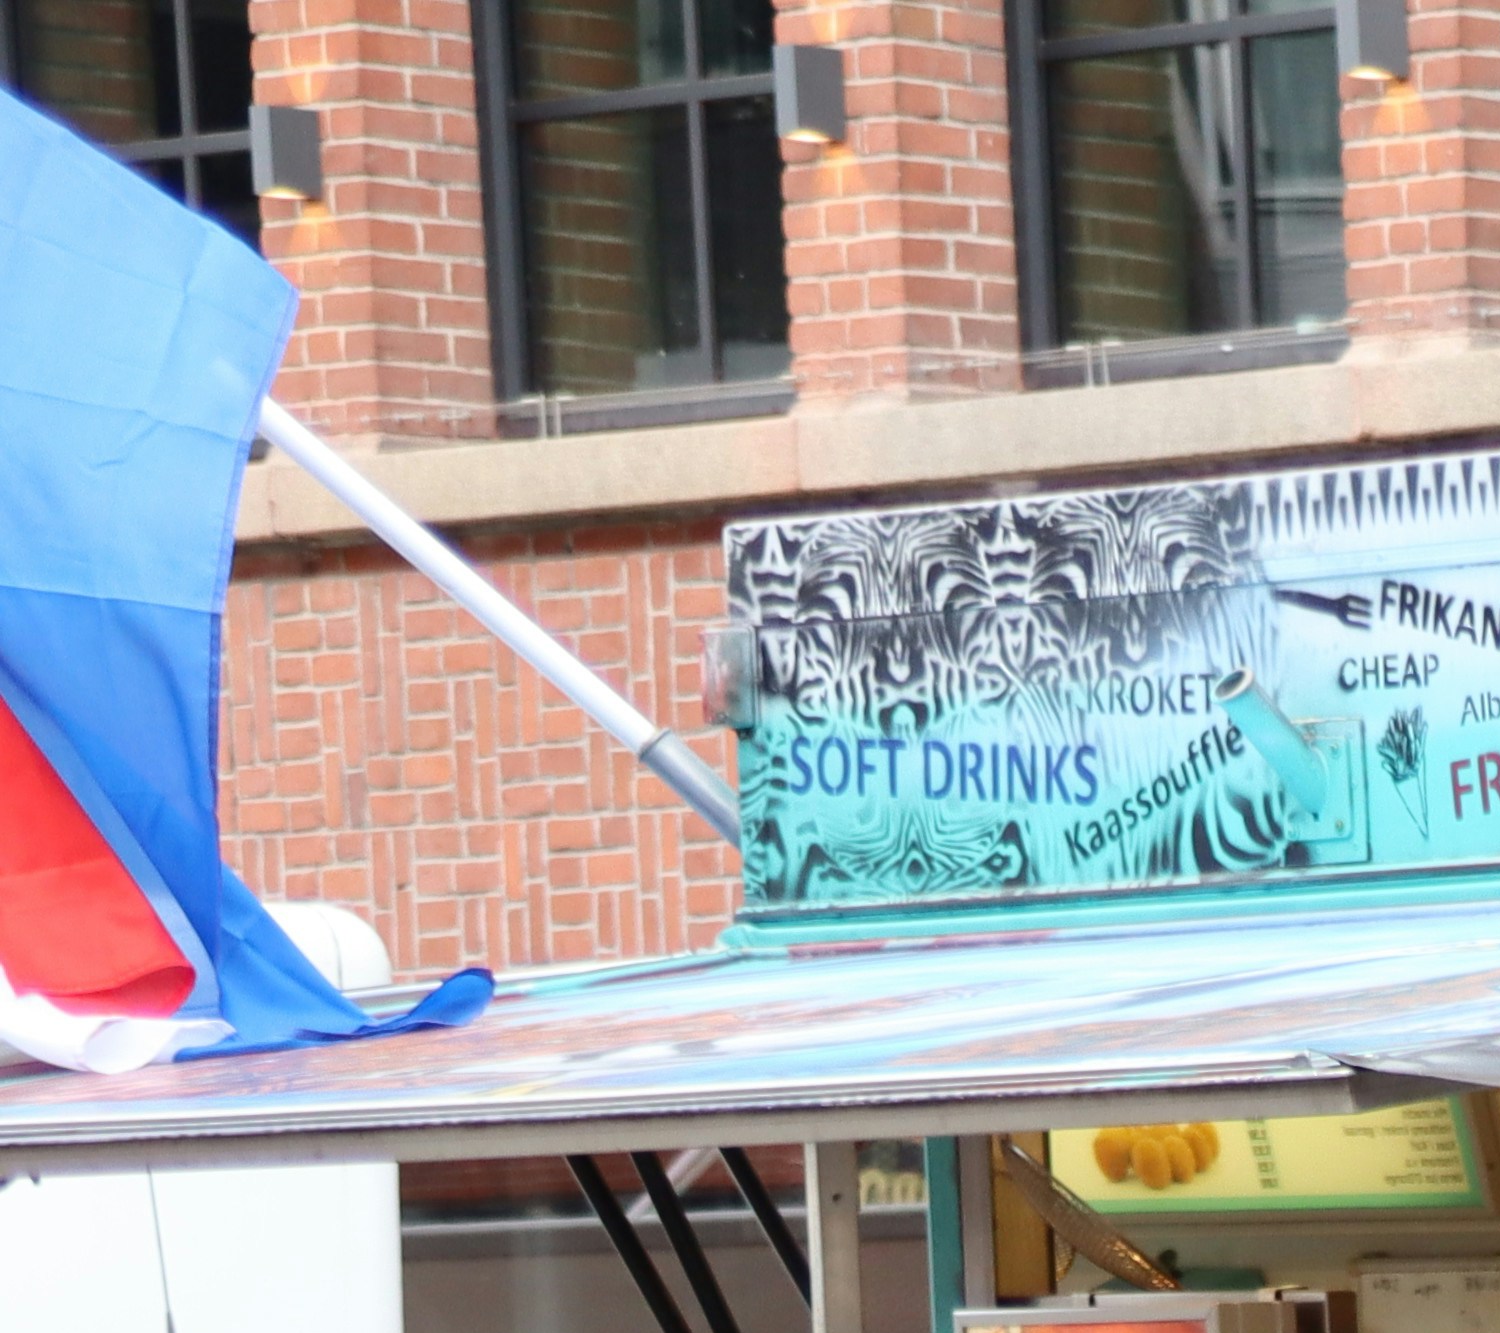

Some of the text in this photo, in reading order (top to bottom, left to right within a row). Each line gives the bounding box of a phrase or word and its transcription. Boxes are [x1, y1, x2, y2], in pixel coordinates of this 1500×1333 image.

[1086, 671, 1215, 717] KROKET
[1338, 653, 1441, 693] CHEAP
[790, 736, 1099, 805] SOFT DRINKS
[1063, 721, 1246, 870] Kaassoufflé
